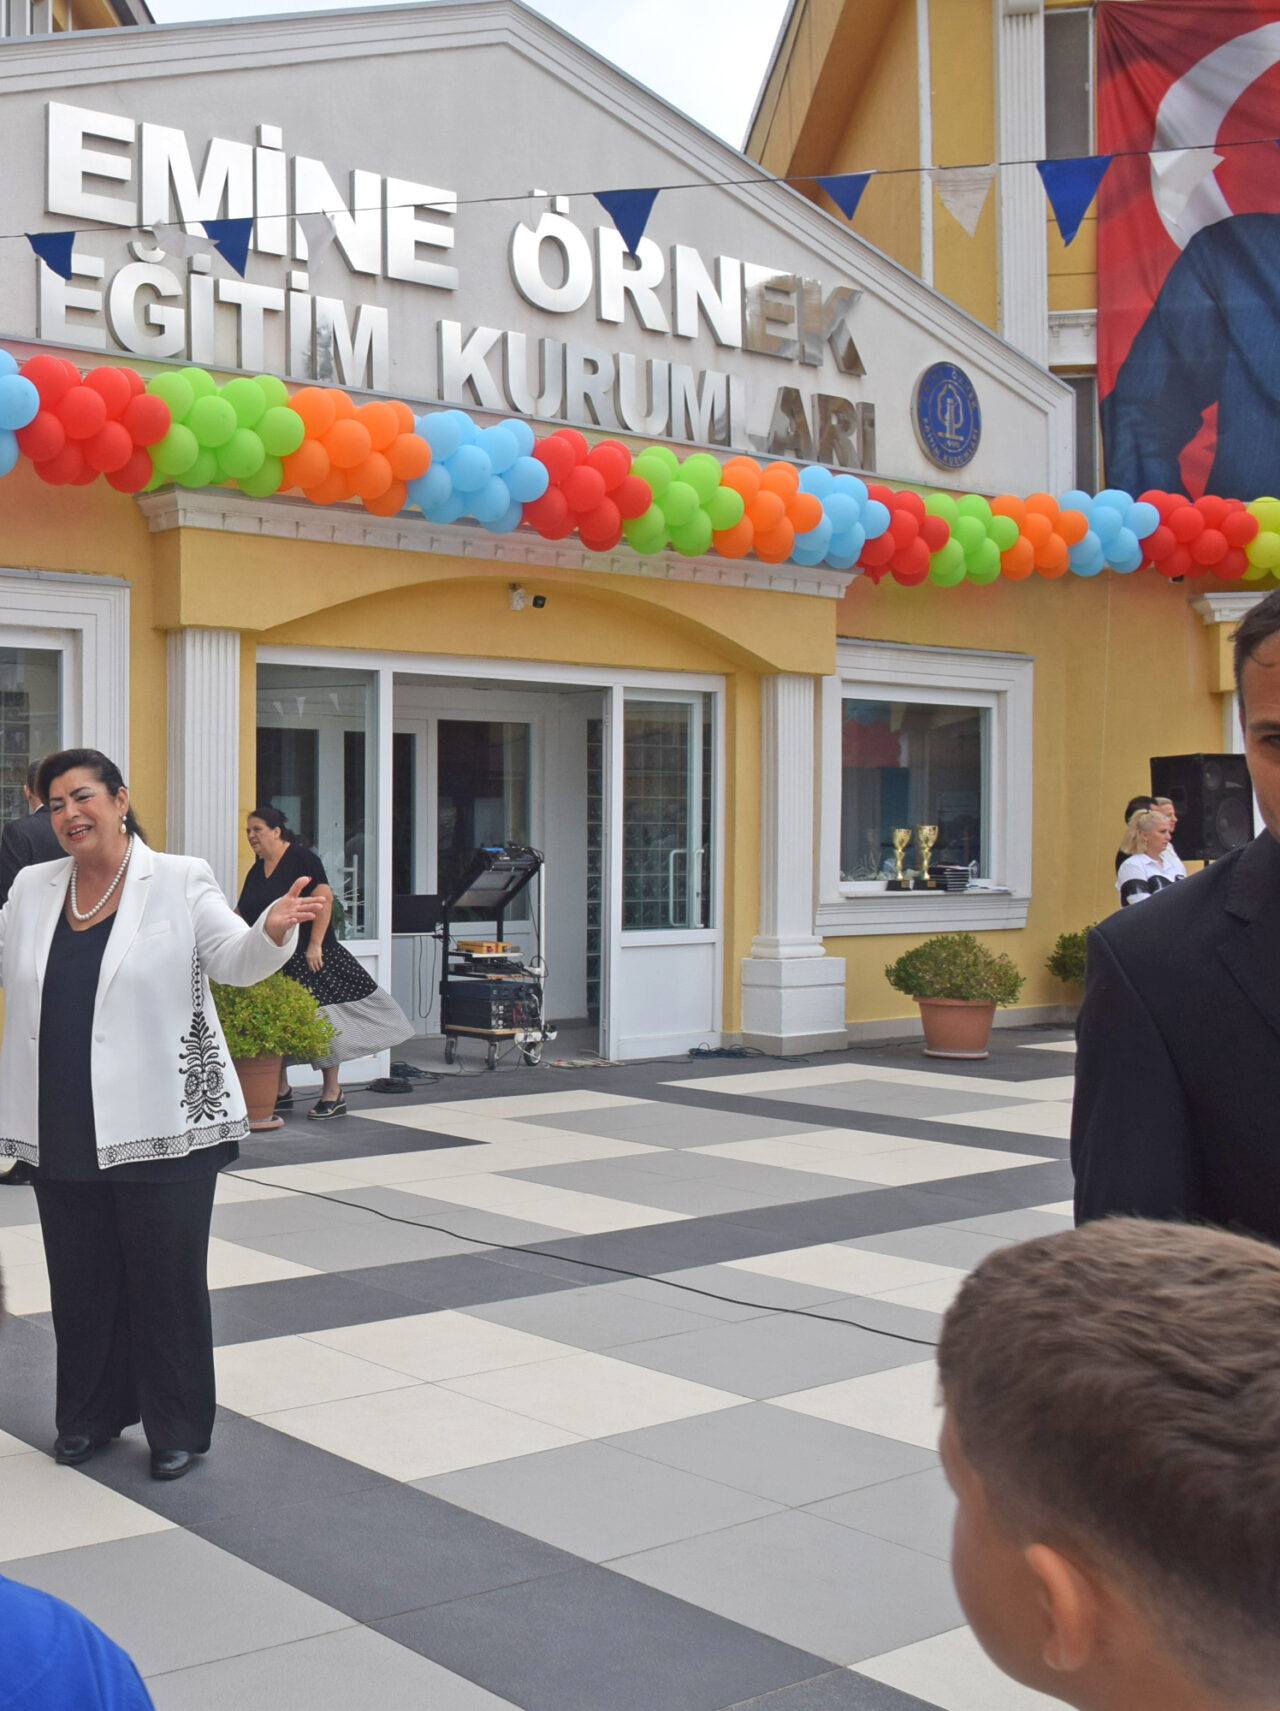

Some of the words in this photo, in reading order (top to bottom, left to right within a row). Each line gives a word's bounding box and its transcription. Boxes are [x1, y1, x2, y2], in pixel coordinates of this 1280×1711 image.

[35, 240, 389, 391] EĞİTİM
[437, 319, 877, 473] KURUMLARI
[45, 101, 459, 291] EMİNE
[509, 188, 868, 376] ÖRNEK
